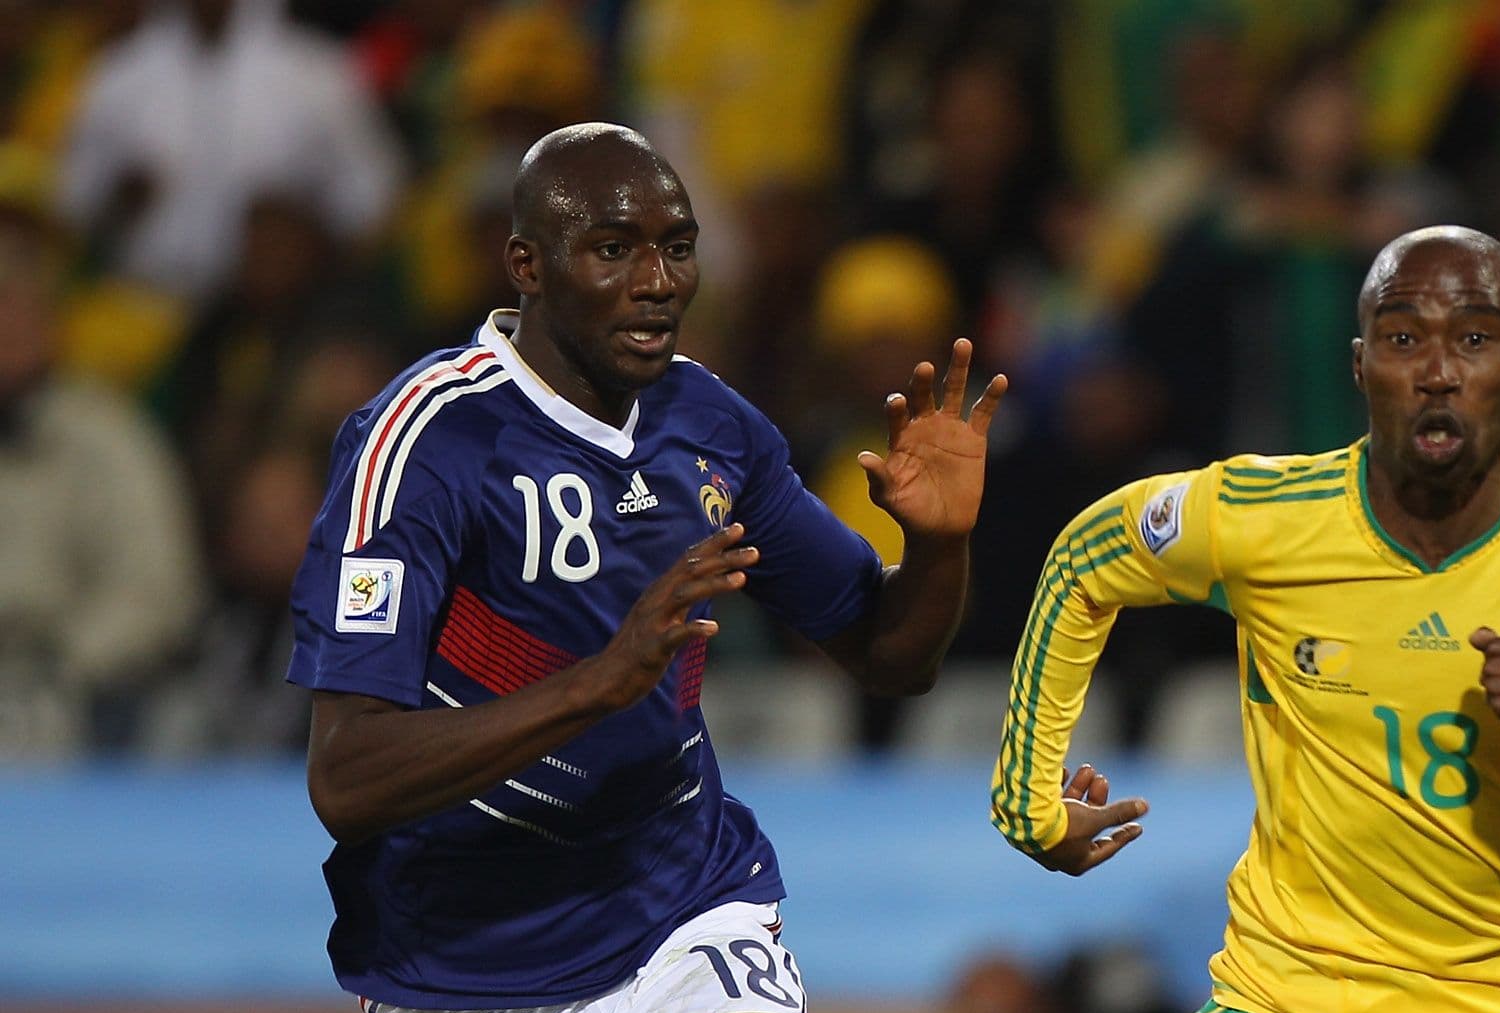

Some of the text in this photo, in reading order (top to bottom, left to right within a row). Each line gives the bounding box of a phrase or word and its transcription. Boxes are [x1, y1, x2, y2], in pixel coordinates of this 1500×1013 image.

[513, 473, 600, 582] 18
[616, 494, 659, 514] adidas
[1399, 639, 1461, 651] adidas
[1373, 705, 1480, 809] 18
[689, 939, 800, 1009] 18
